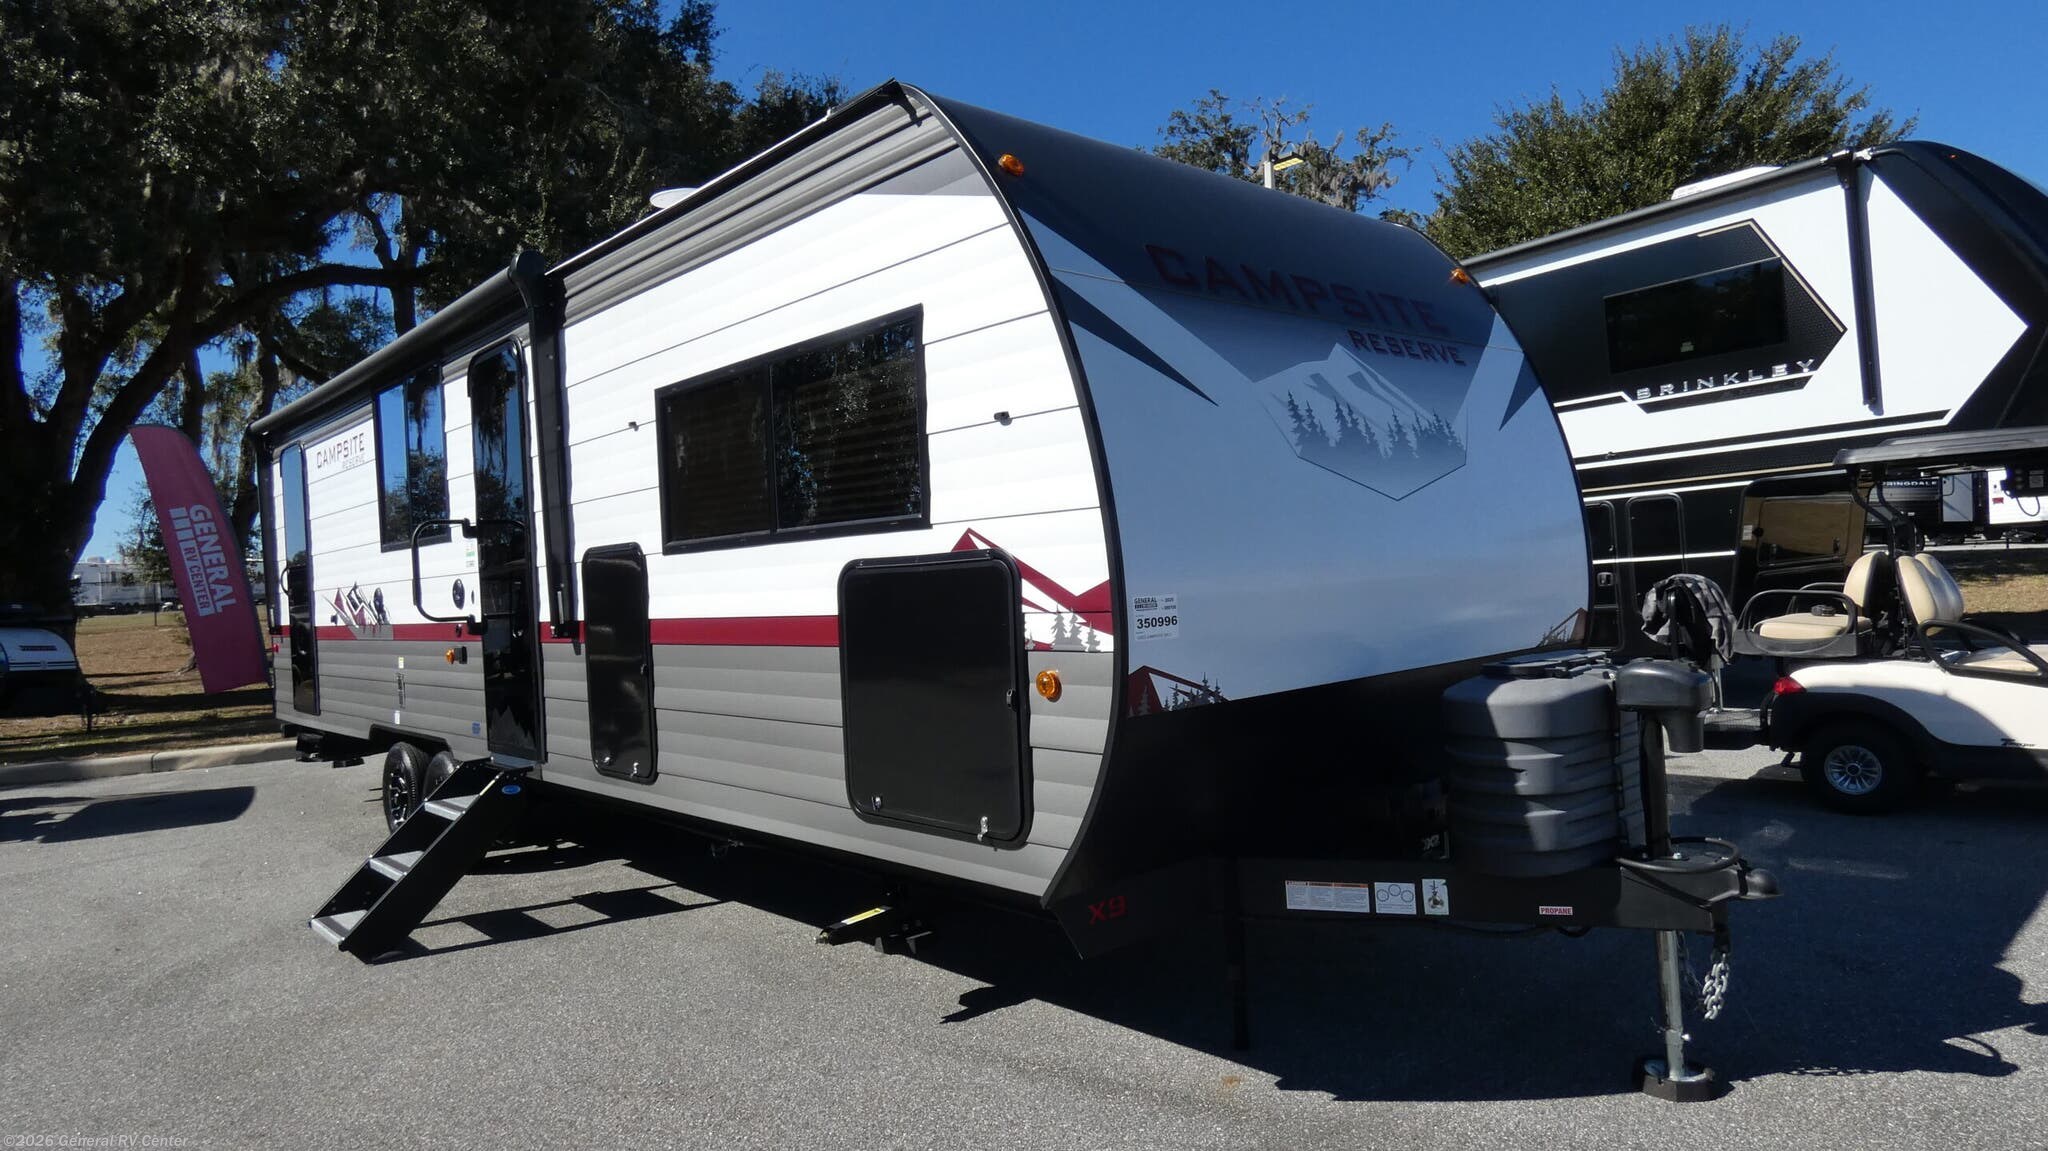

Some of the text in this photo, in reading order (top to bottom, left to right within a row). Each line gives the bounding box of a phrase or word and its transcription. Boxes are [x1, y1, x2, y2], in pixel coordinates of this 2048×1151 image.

[1145, 244, 1450, 335] CAMPSITE
[1347, 330, 1467, 366] RESERVE
[1636, 359, 1815, 400] BRINKLEY
[316, 432, 365, 469] CAMPSITE
[188, 504, 237, 614] GENERAL
[183, 546, 211, 610] RV CENTER
[1136, 615, 1178, 629] 350996
[1087, 895, 1128, 925] X9
[1540, 907, 1573, 915] PROPANE
